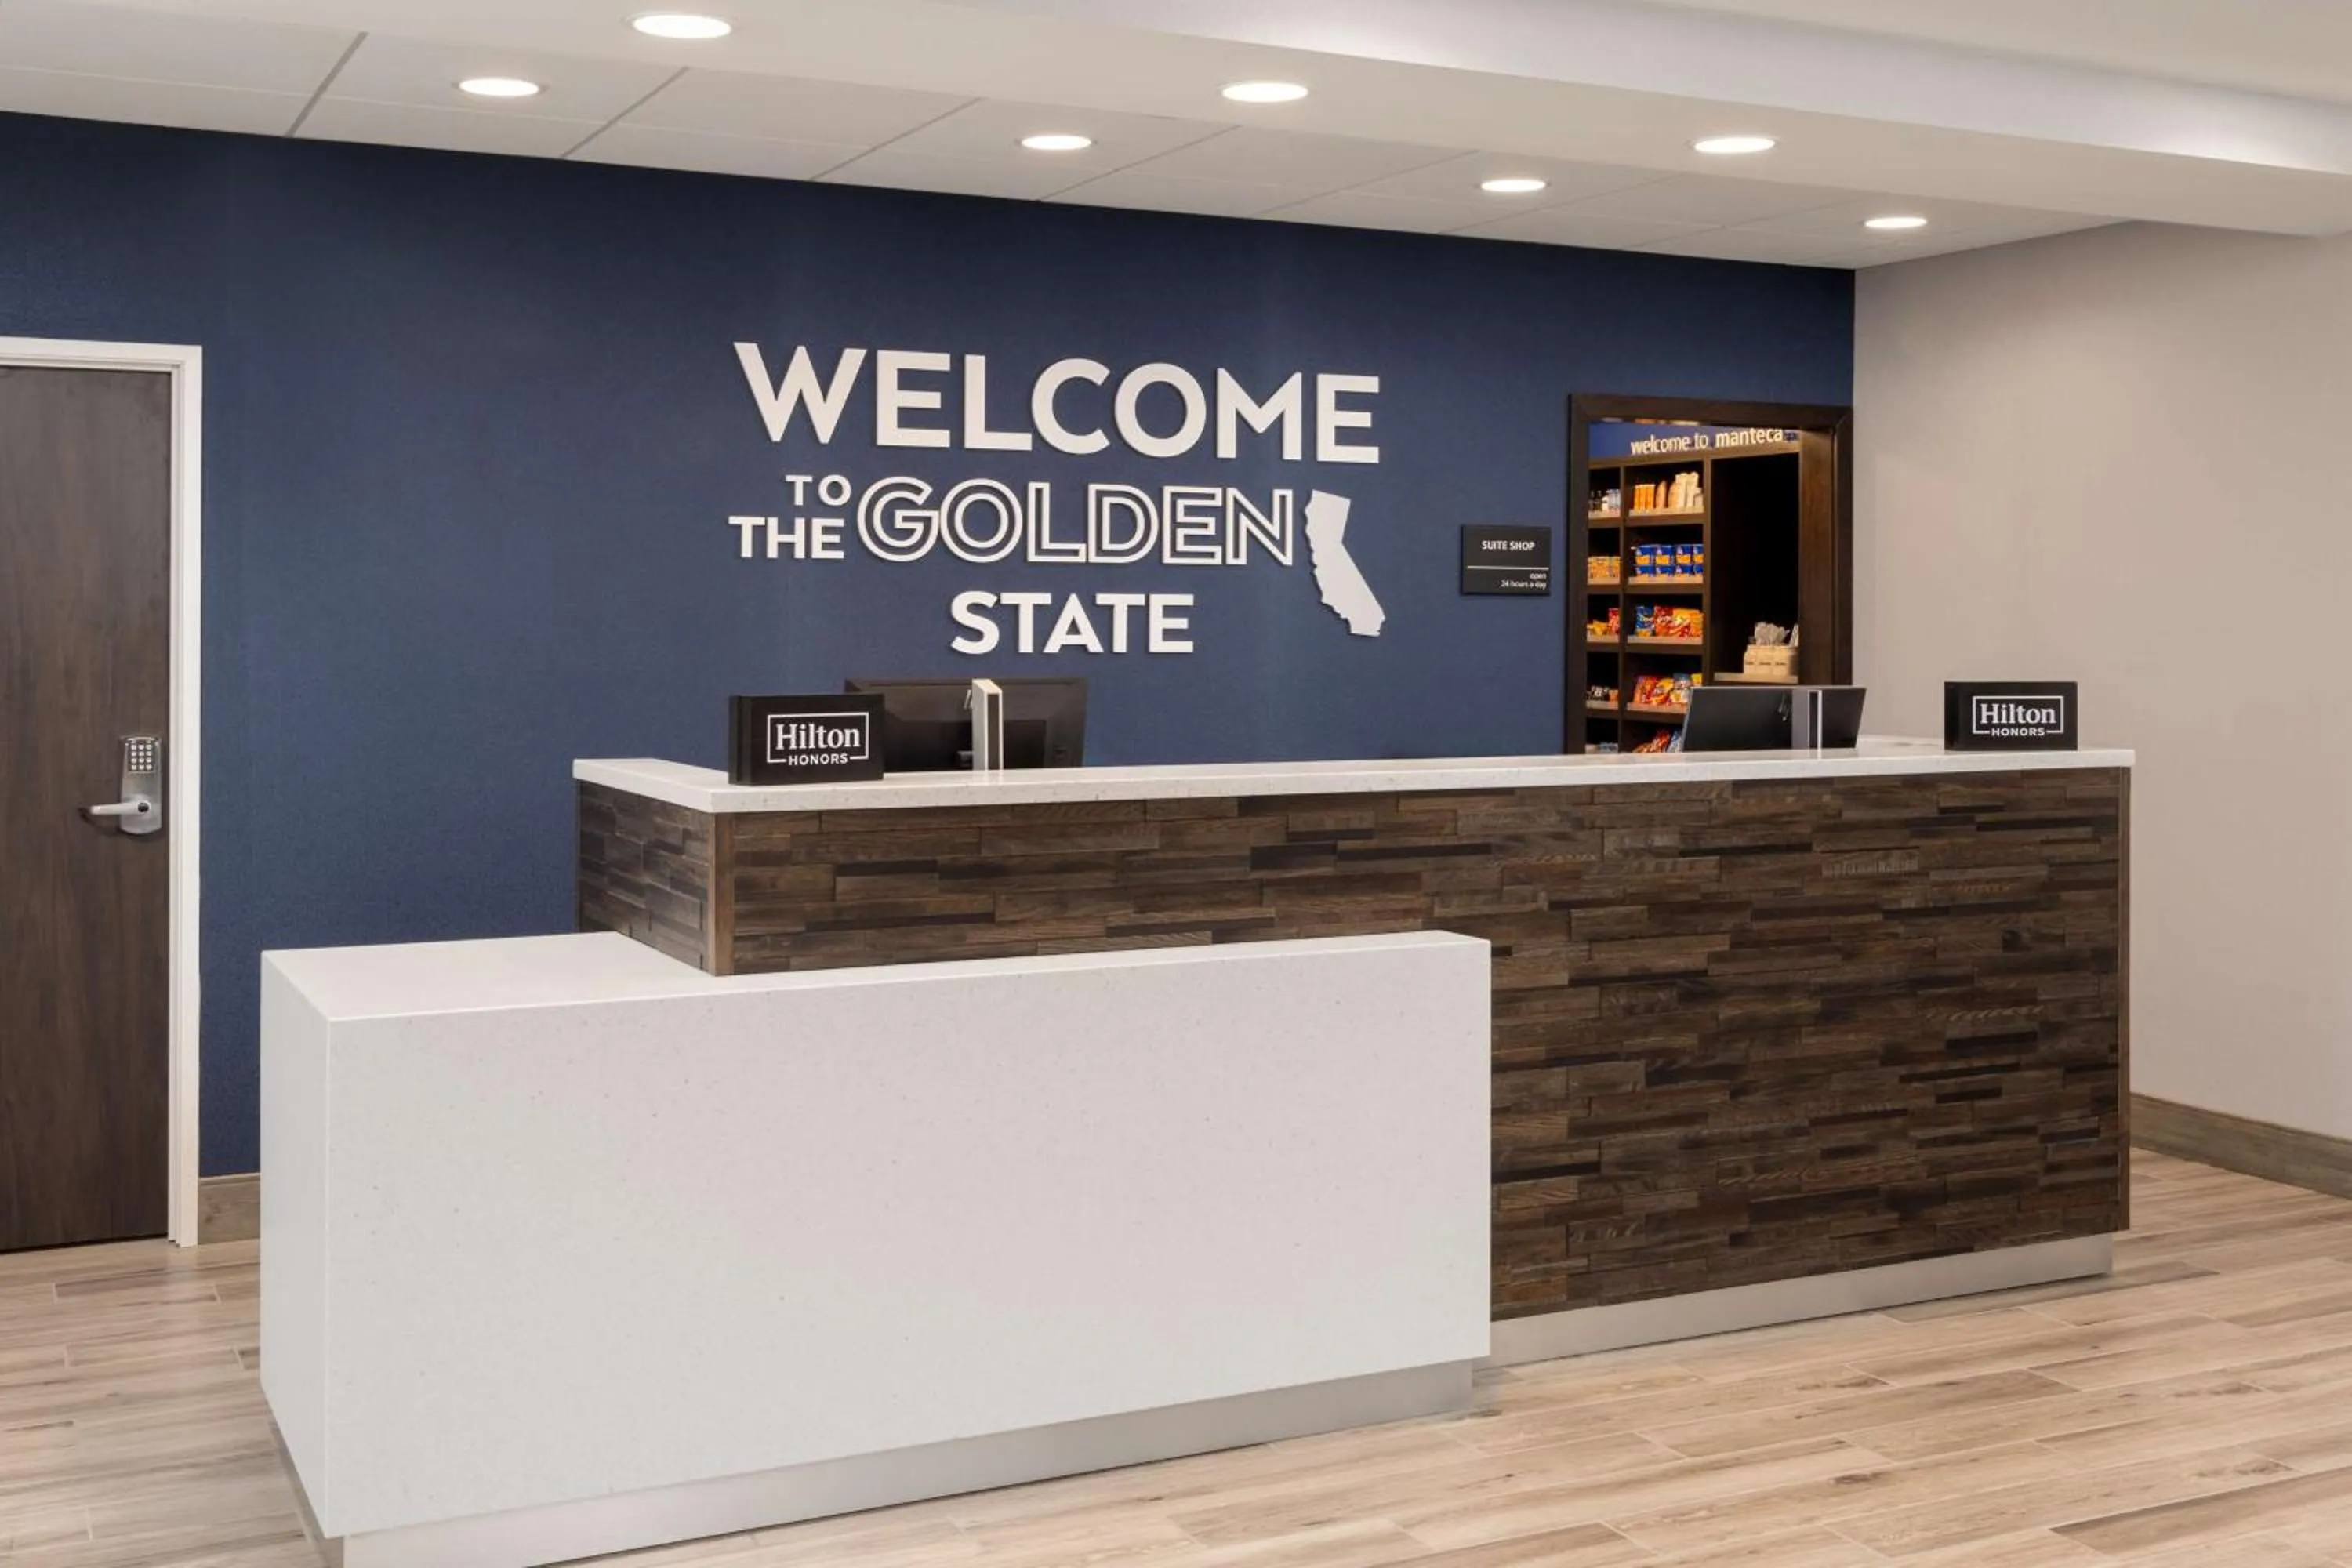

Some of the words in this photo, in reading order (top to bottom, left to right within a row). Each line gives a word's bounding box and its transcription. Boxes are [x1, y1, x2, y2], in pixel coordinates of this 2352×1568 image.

[733, 342, 1380, 464] WELCOME
[1630, 434, 1690, 455] welcome
[1694, 433, 1708, 450] to
[1715, 428, 1784, 448] manteca
[785, 474, 852, 506] TO
[728, 515, 845, 559] THE
[857, 476, 1294, 566] GOLDEN
[1481, 540, 1508, 550] SUITE
[1509, 540, 1536, 551] SHOP
[950, 590, 1195, 655] STATE
[1980, 702, 2056, 724] Hilton
[775, 723, 861, 750] Hilton
[1991, 727, 2045, 737] HONORS
[788, 752, 848, 766] HONORS
